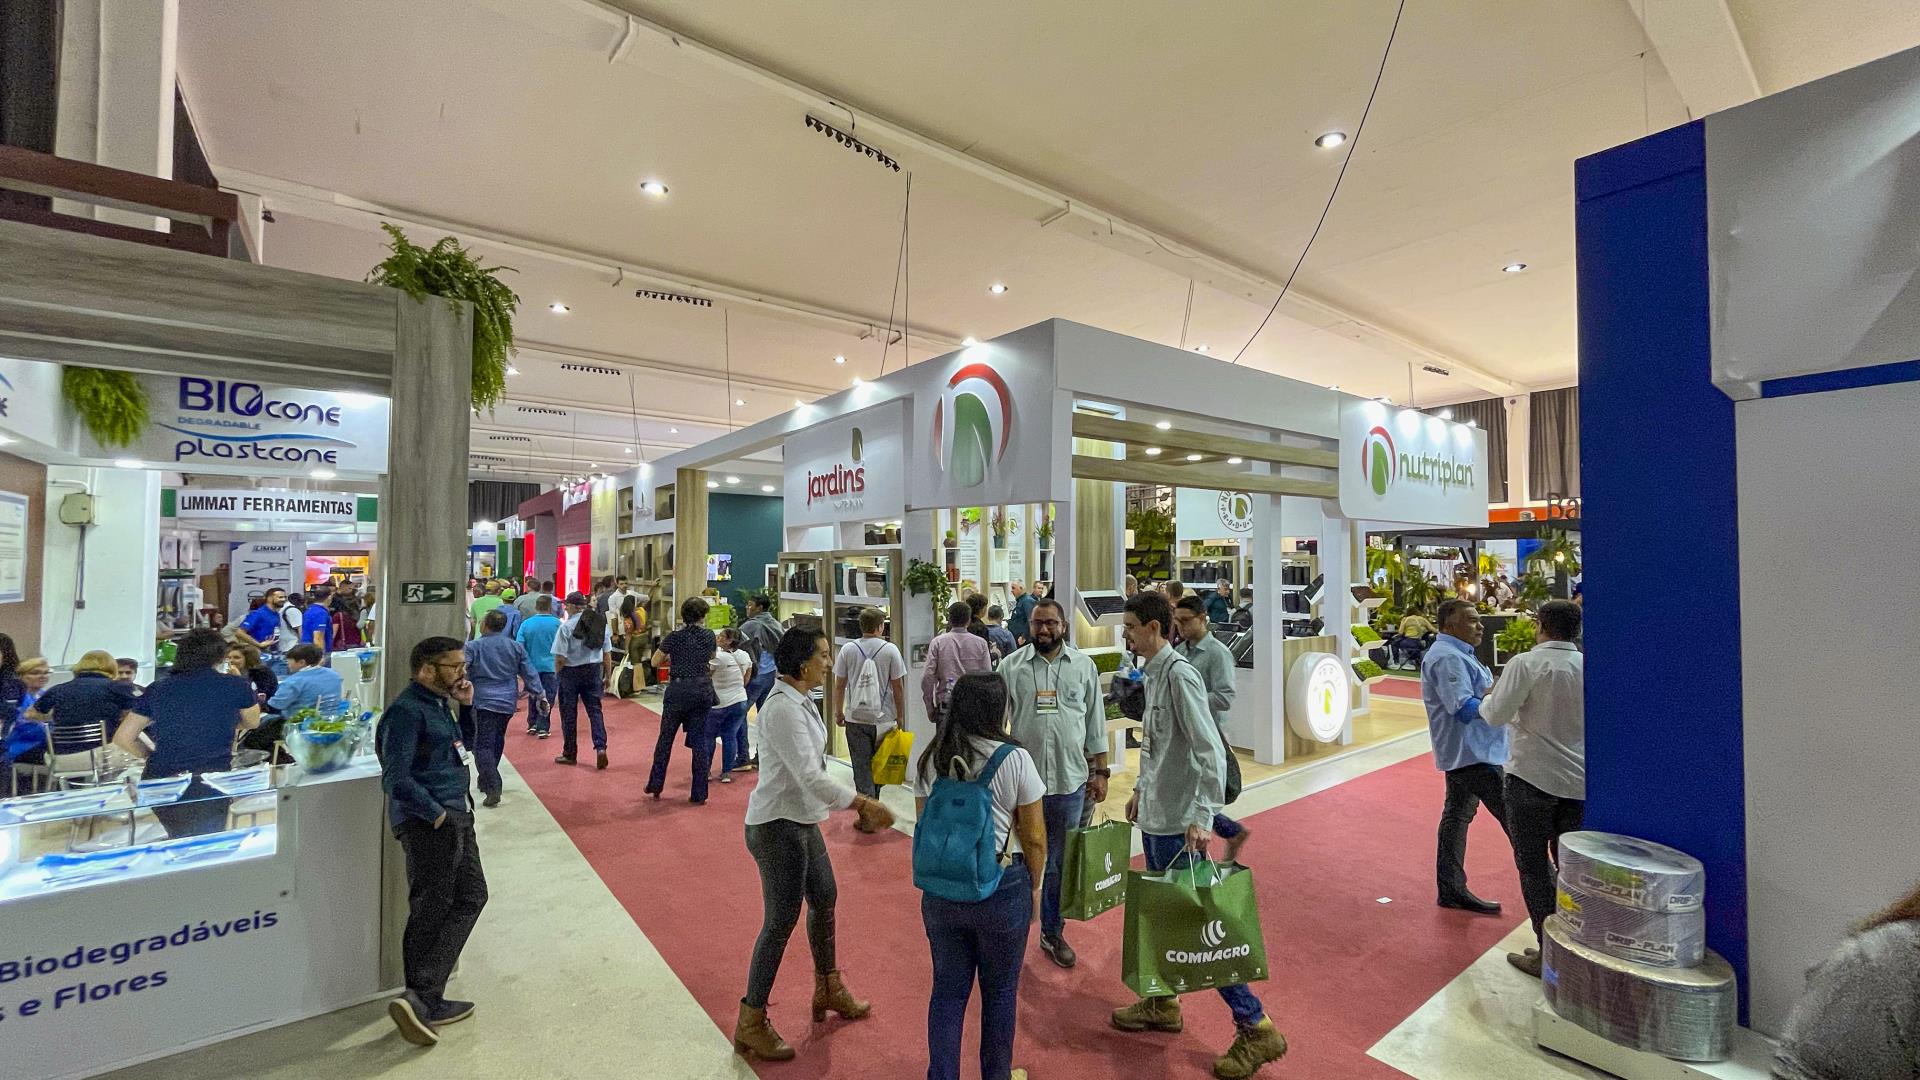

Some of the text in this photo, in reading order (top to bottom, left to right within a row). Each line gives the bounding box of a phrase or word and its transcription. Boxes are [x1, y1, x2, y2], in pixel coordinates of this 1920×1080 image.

[175, 439, 337, 463] plastcone
[1399, 451, 1474, 491] nutriplan
[806, 463, 865, 506] jardins
[181, 496, 353, 516] LIMMAT FERRAMENTAS
[0, 910, 279, 984] Biodegradáveis
[1165, 944, 1250, 964] COMNAGRO
[19, 998, 42, 1018] e
[54, 970, 168, 1010] Flores
